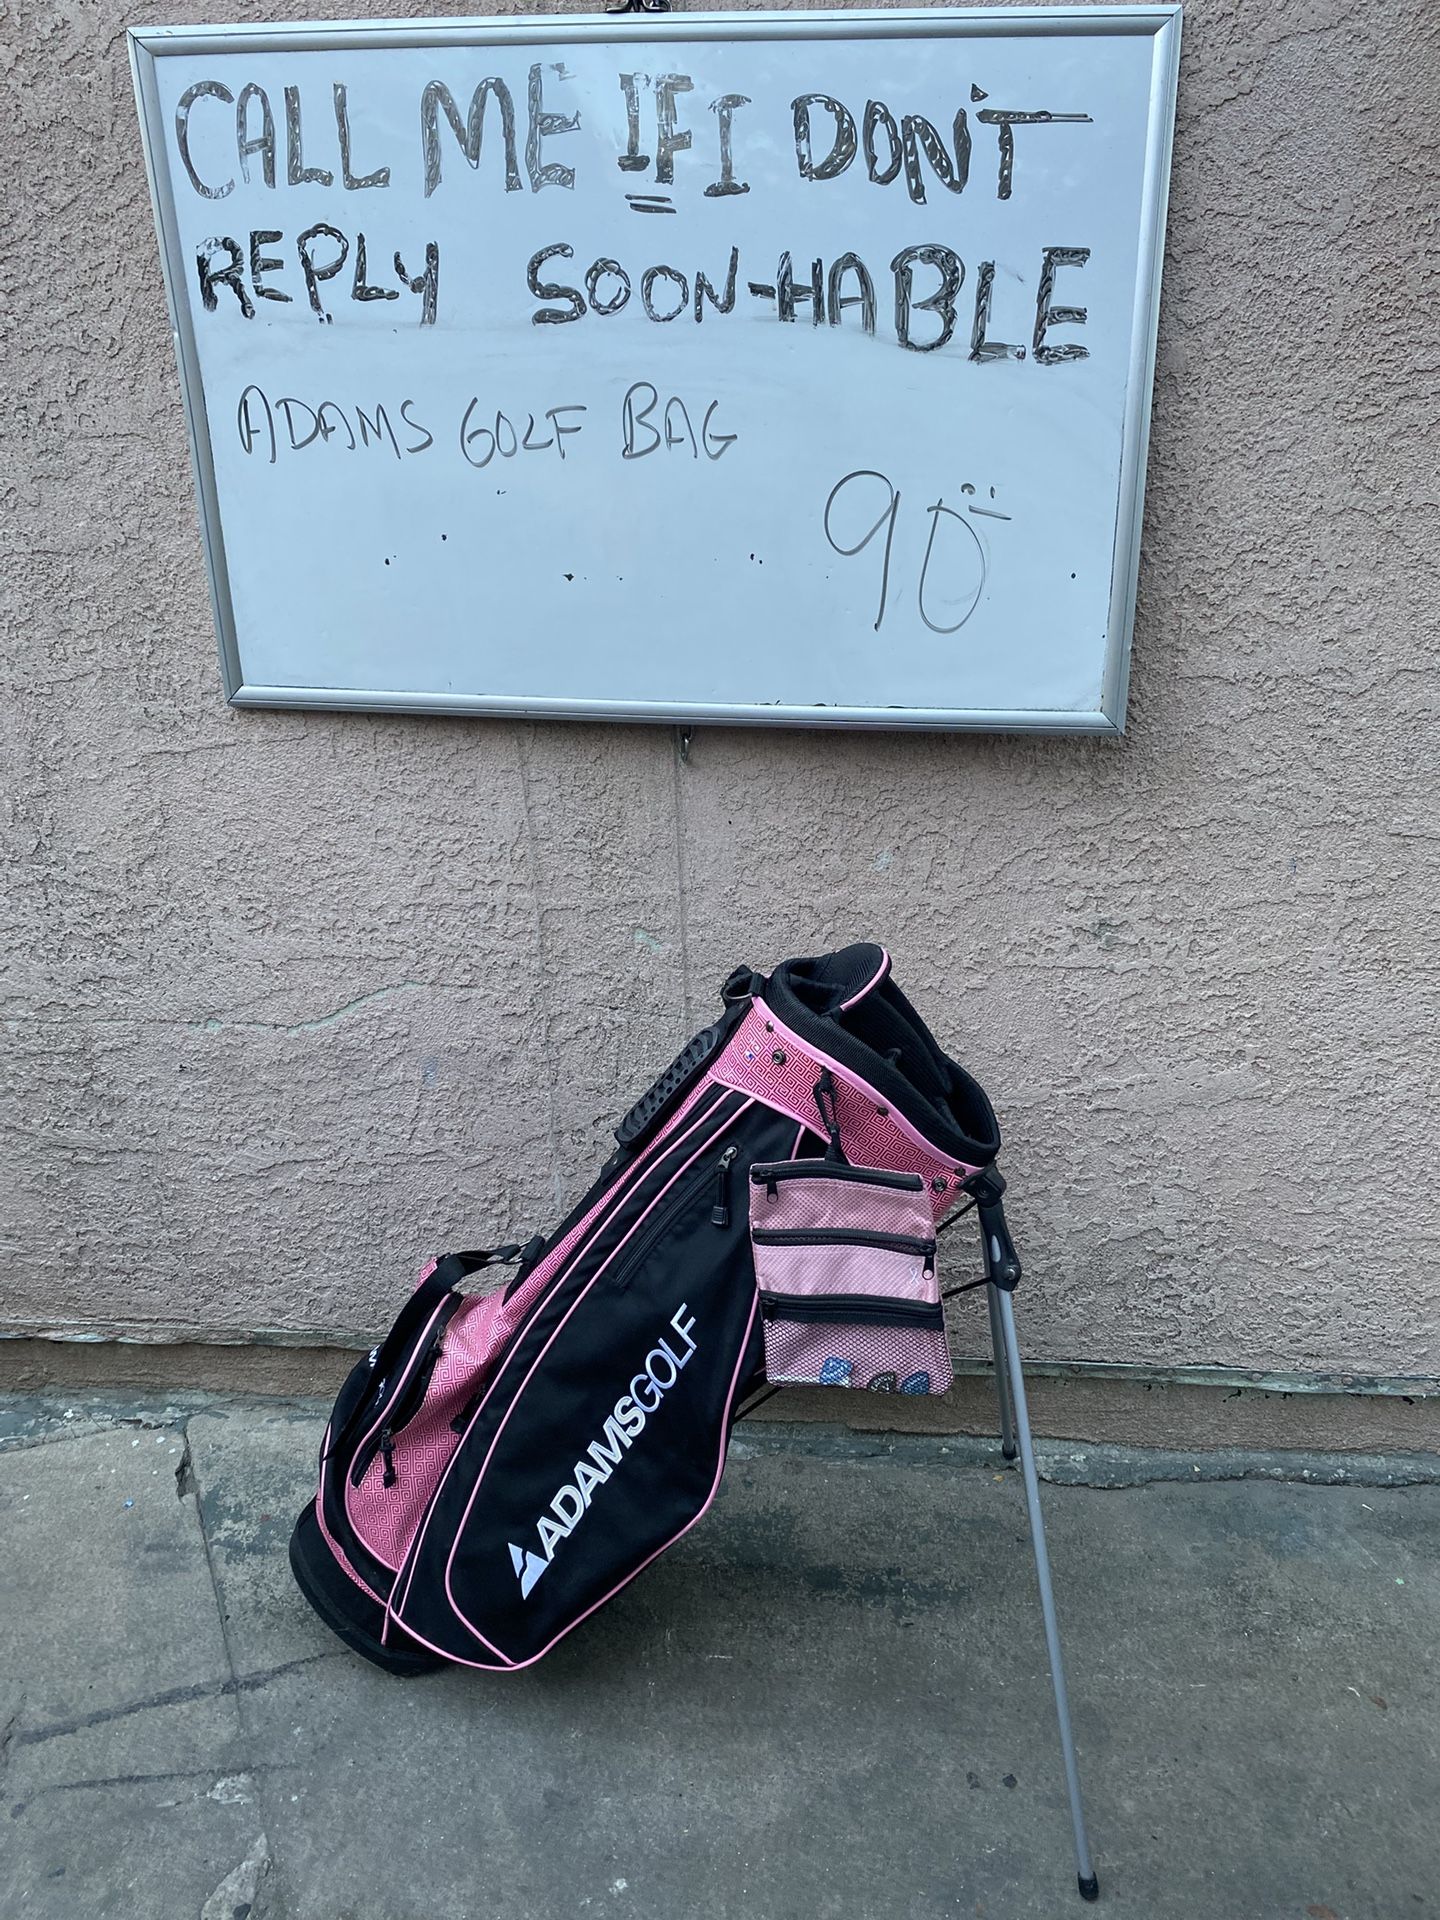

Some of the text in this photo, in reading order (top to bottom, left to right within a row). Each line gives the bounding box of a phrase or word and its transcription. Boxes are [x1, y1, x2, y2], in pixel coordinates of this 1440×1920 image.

[176, 80, 391, 199] CALL
[420, 62, 582, 198] ME
[617, 72, 695, 184] IF
[703, 93, 752, 197] I
[195, 222, 439, 326] REPLY
[237, 381, 738, 467] ADAMS GOLF BAG
